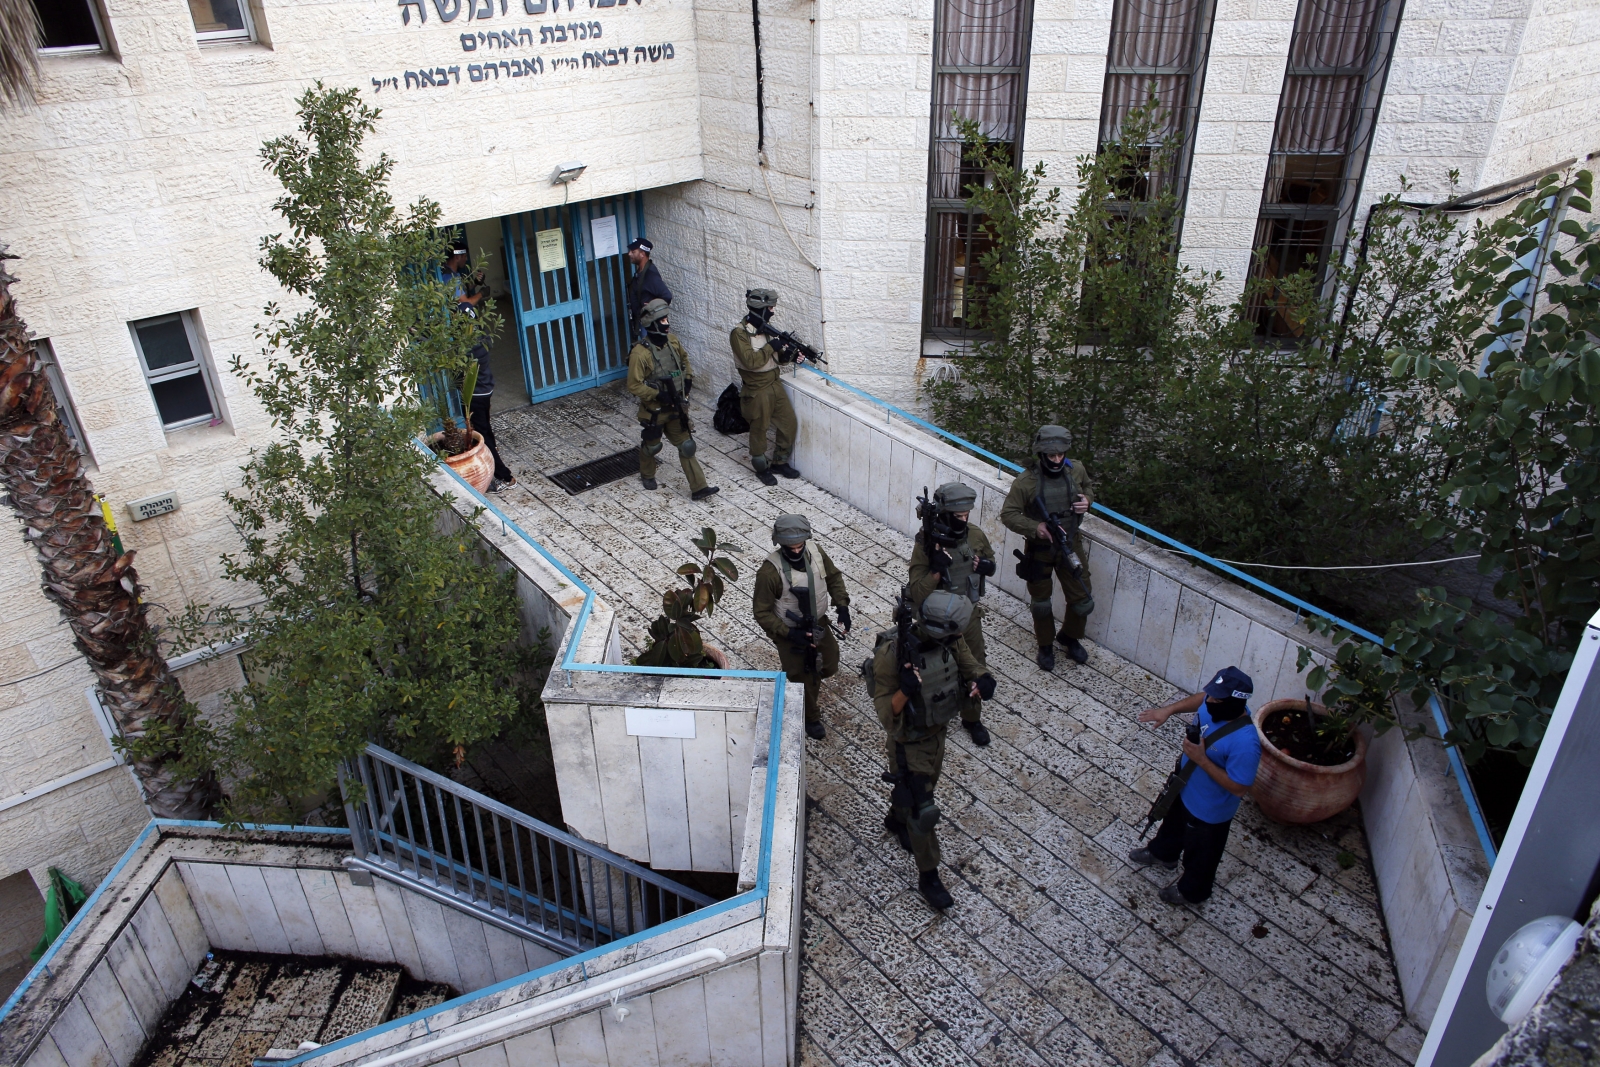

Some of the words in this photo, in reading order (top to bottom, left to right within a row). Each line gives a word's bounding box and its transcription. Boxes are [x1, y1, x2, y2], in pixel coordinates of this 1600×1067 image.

[460, 27, 533, 52] האחים
[540, 21, 602, 44] מנדבת
[582, 46, 629, 69] דבאח
[634, 43, 675, 65] משה
[404, 65, 460, 90] דבאח
[467, 56, 544, 82] ואברהם
[140, 498, 173, 511] מינהלת
[142, 504, 174, 518] הר-נוף
